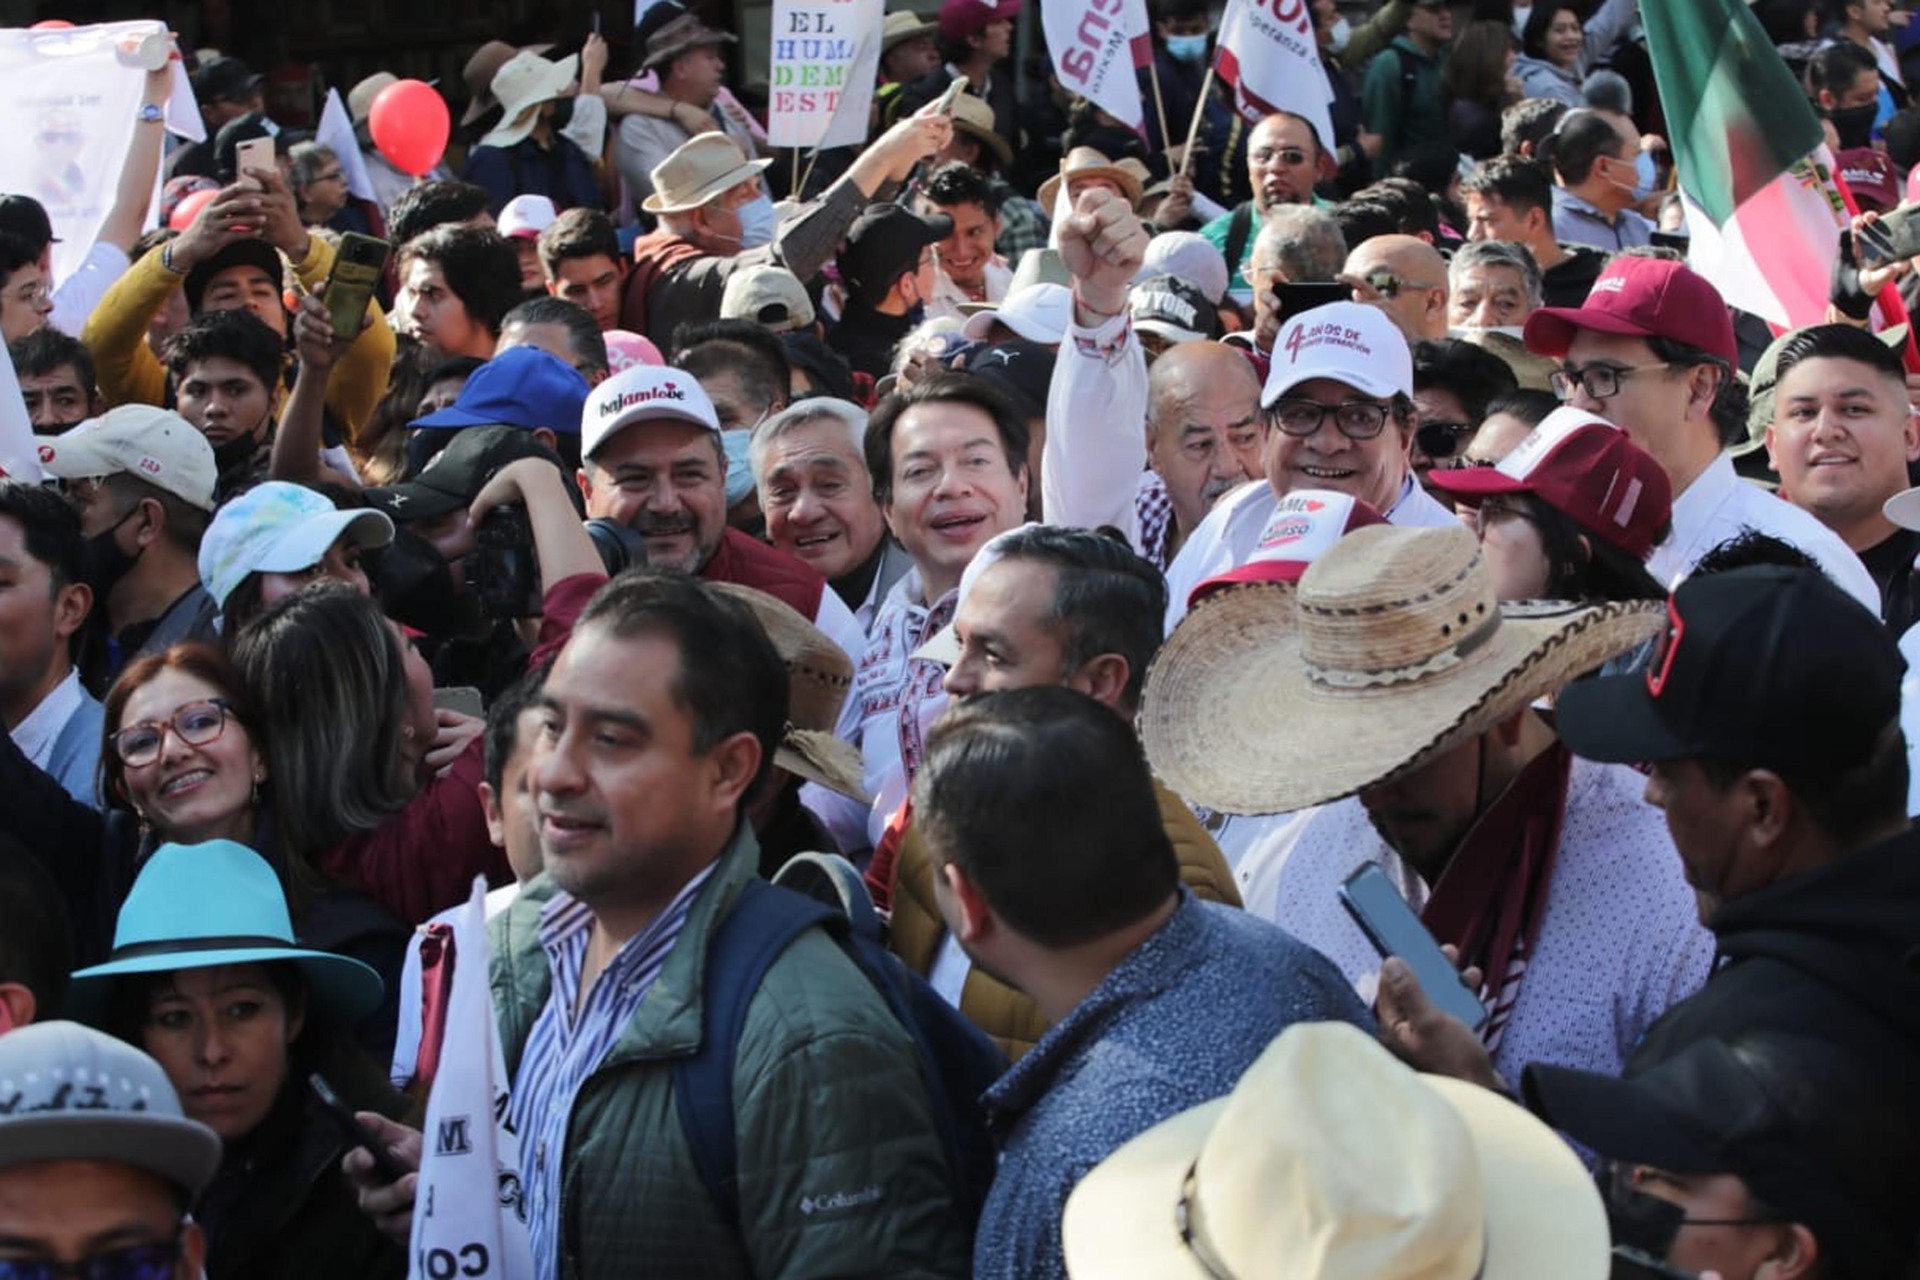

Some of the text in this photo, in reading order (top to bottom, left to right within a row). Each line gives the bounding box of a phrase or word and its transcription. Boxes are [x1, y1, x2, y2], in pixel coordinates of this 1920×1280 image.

[789, 12, 834, 33] EL
[1285, 323, 1306, 364] 4
[1345, 328, 1362, 340] DE
